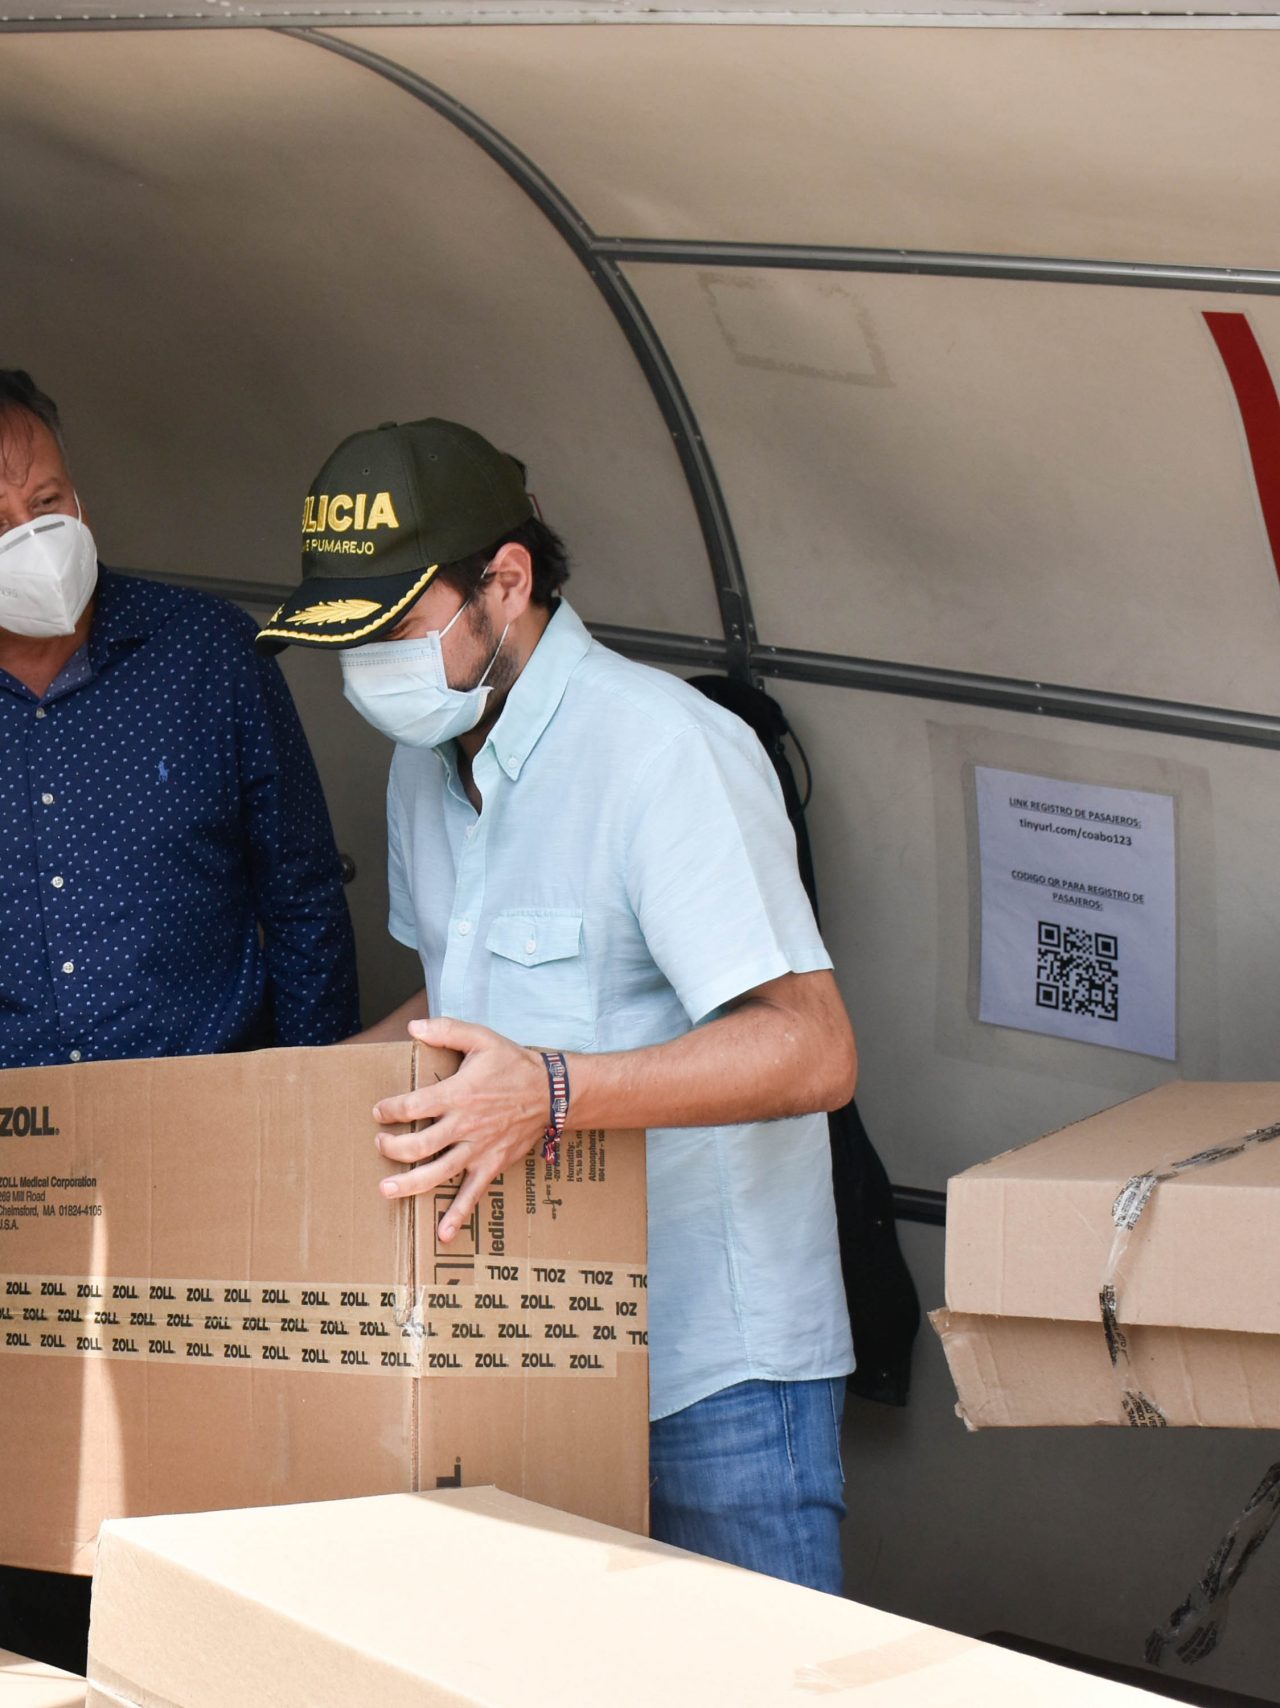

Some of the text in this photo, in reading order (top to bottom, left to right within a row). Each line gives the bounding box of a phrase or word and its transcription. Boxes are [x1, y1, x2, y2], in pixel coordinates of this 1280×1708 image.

[311, 539, 374, 554] PUMAREJO
[1009, 797, 1142, 827] LINK REGISTRO DE PASAJEROS:
[1019, 818, 1133, 846] tinyurl.com/coabo123
[1011, 870, 1144, 903] CODIGO QR PARA REGISTRO DE
[1052, 892, 1103, 911] PASAJEROS:
[20, 1176, 49, 1188] Medical
[50, 1176, 97, 1190] Corporation
[525, 1159, 536, 1214] SHIPPING
[26, 1190, 46, 1201] Road
[42, 1205, 56, 1216] MA
[59, 1205, 102, 1216] 01824-4105
[6, 1282, 31, 1295] ZOLL
[40, 1282, 66, 1296] ZOLL
[77, 1284, 102, 1298] ZOLL
[112, 1285, 139, 1299] ZOLL
[149, 1286, 176, 1300] ZOLL
[186, 1288, 214, 1302] ZOLL
[224, 1289, 251, 1303] ZOLL
[262, 1289, 290, 1304] ZOLL
[301, 1291, 330, 1306] ZOLL
[340, 1292, 370, 1307] ZOLL
[428, 1293, 604, 1311] ZOLL ZOLL ZOLL ZOLL
[452, 1323, 486, 1338] ZOLL
[498, 1324, 532, 1338] ZOLL
[544, 1324, 579, 1339] ZOLL
[6, 1333, 31, 1346] ZOLL
[40, 1334, 66, 1347] ZOLL
[77, 1337, 102, 1350] ZOLL
[112, 1338, 139, 1352] ZOLL
[149, 1340, 176, 1353] ZOLL
[186, 1343, 213, 1357] ZOLL
[224, 1344, 251, 1358] ZOLL
[262, 1345, 290, 1360] ZOLL
[301, 1348, 330, 1363] ZOLL
[341, 1350, 369, 1365] ZOLL
[429, 1353, 604, 1369] ZOLL ZOLL ZOLL ZOLL
